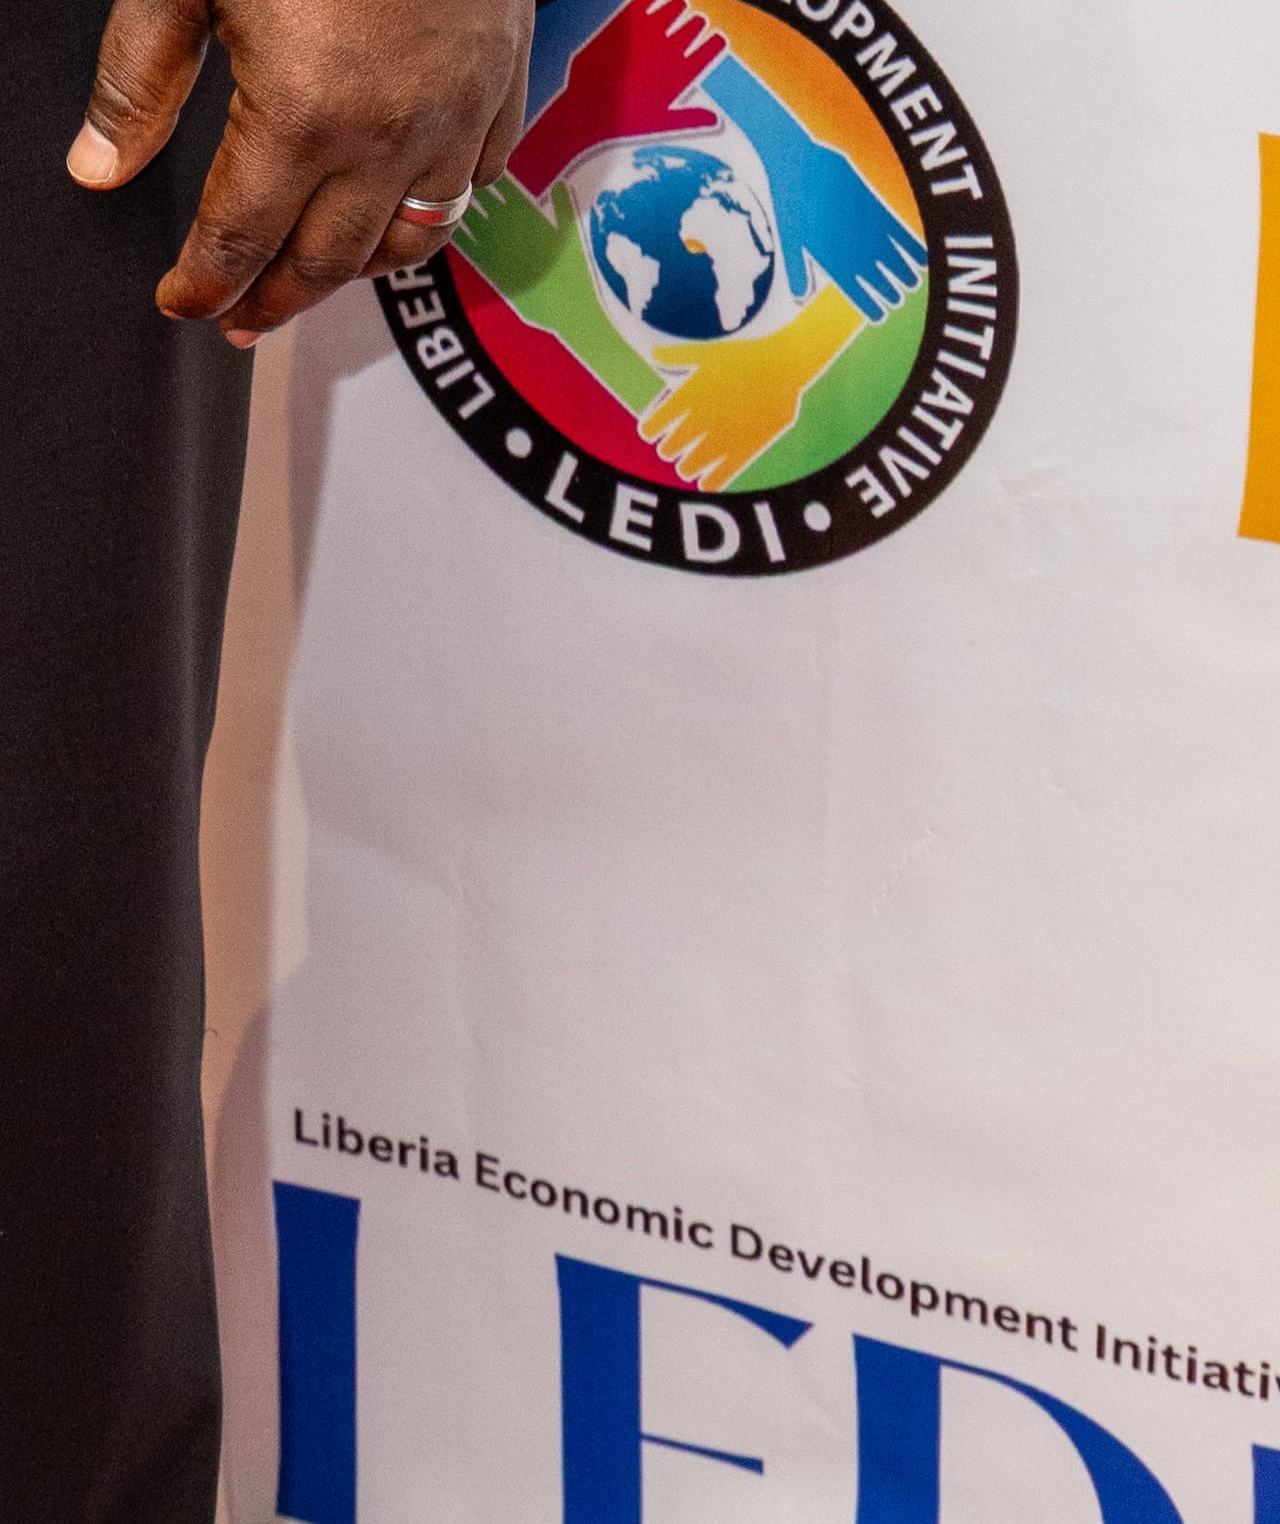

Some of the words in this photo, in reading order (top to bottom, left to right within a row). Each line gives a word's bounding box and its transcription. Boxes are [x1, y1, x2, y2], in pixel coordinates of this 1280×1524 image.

[844, 235, 997, 519] INITIATIVE
[546, 451, 788, 564] LEDI
[293, 1107, 459, 1180] Liberia
[476, 1152, 714, 1251] Economic
[729, 1223, 1077, 1352] Development
